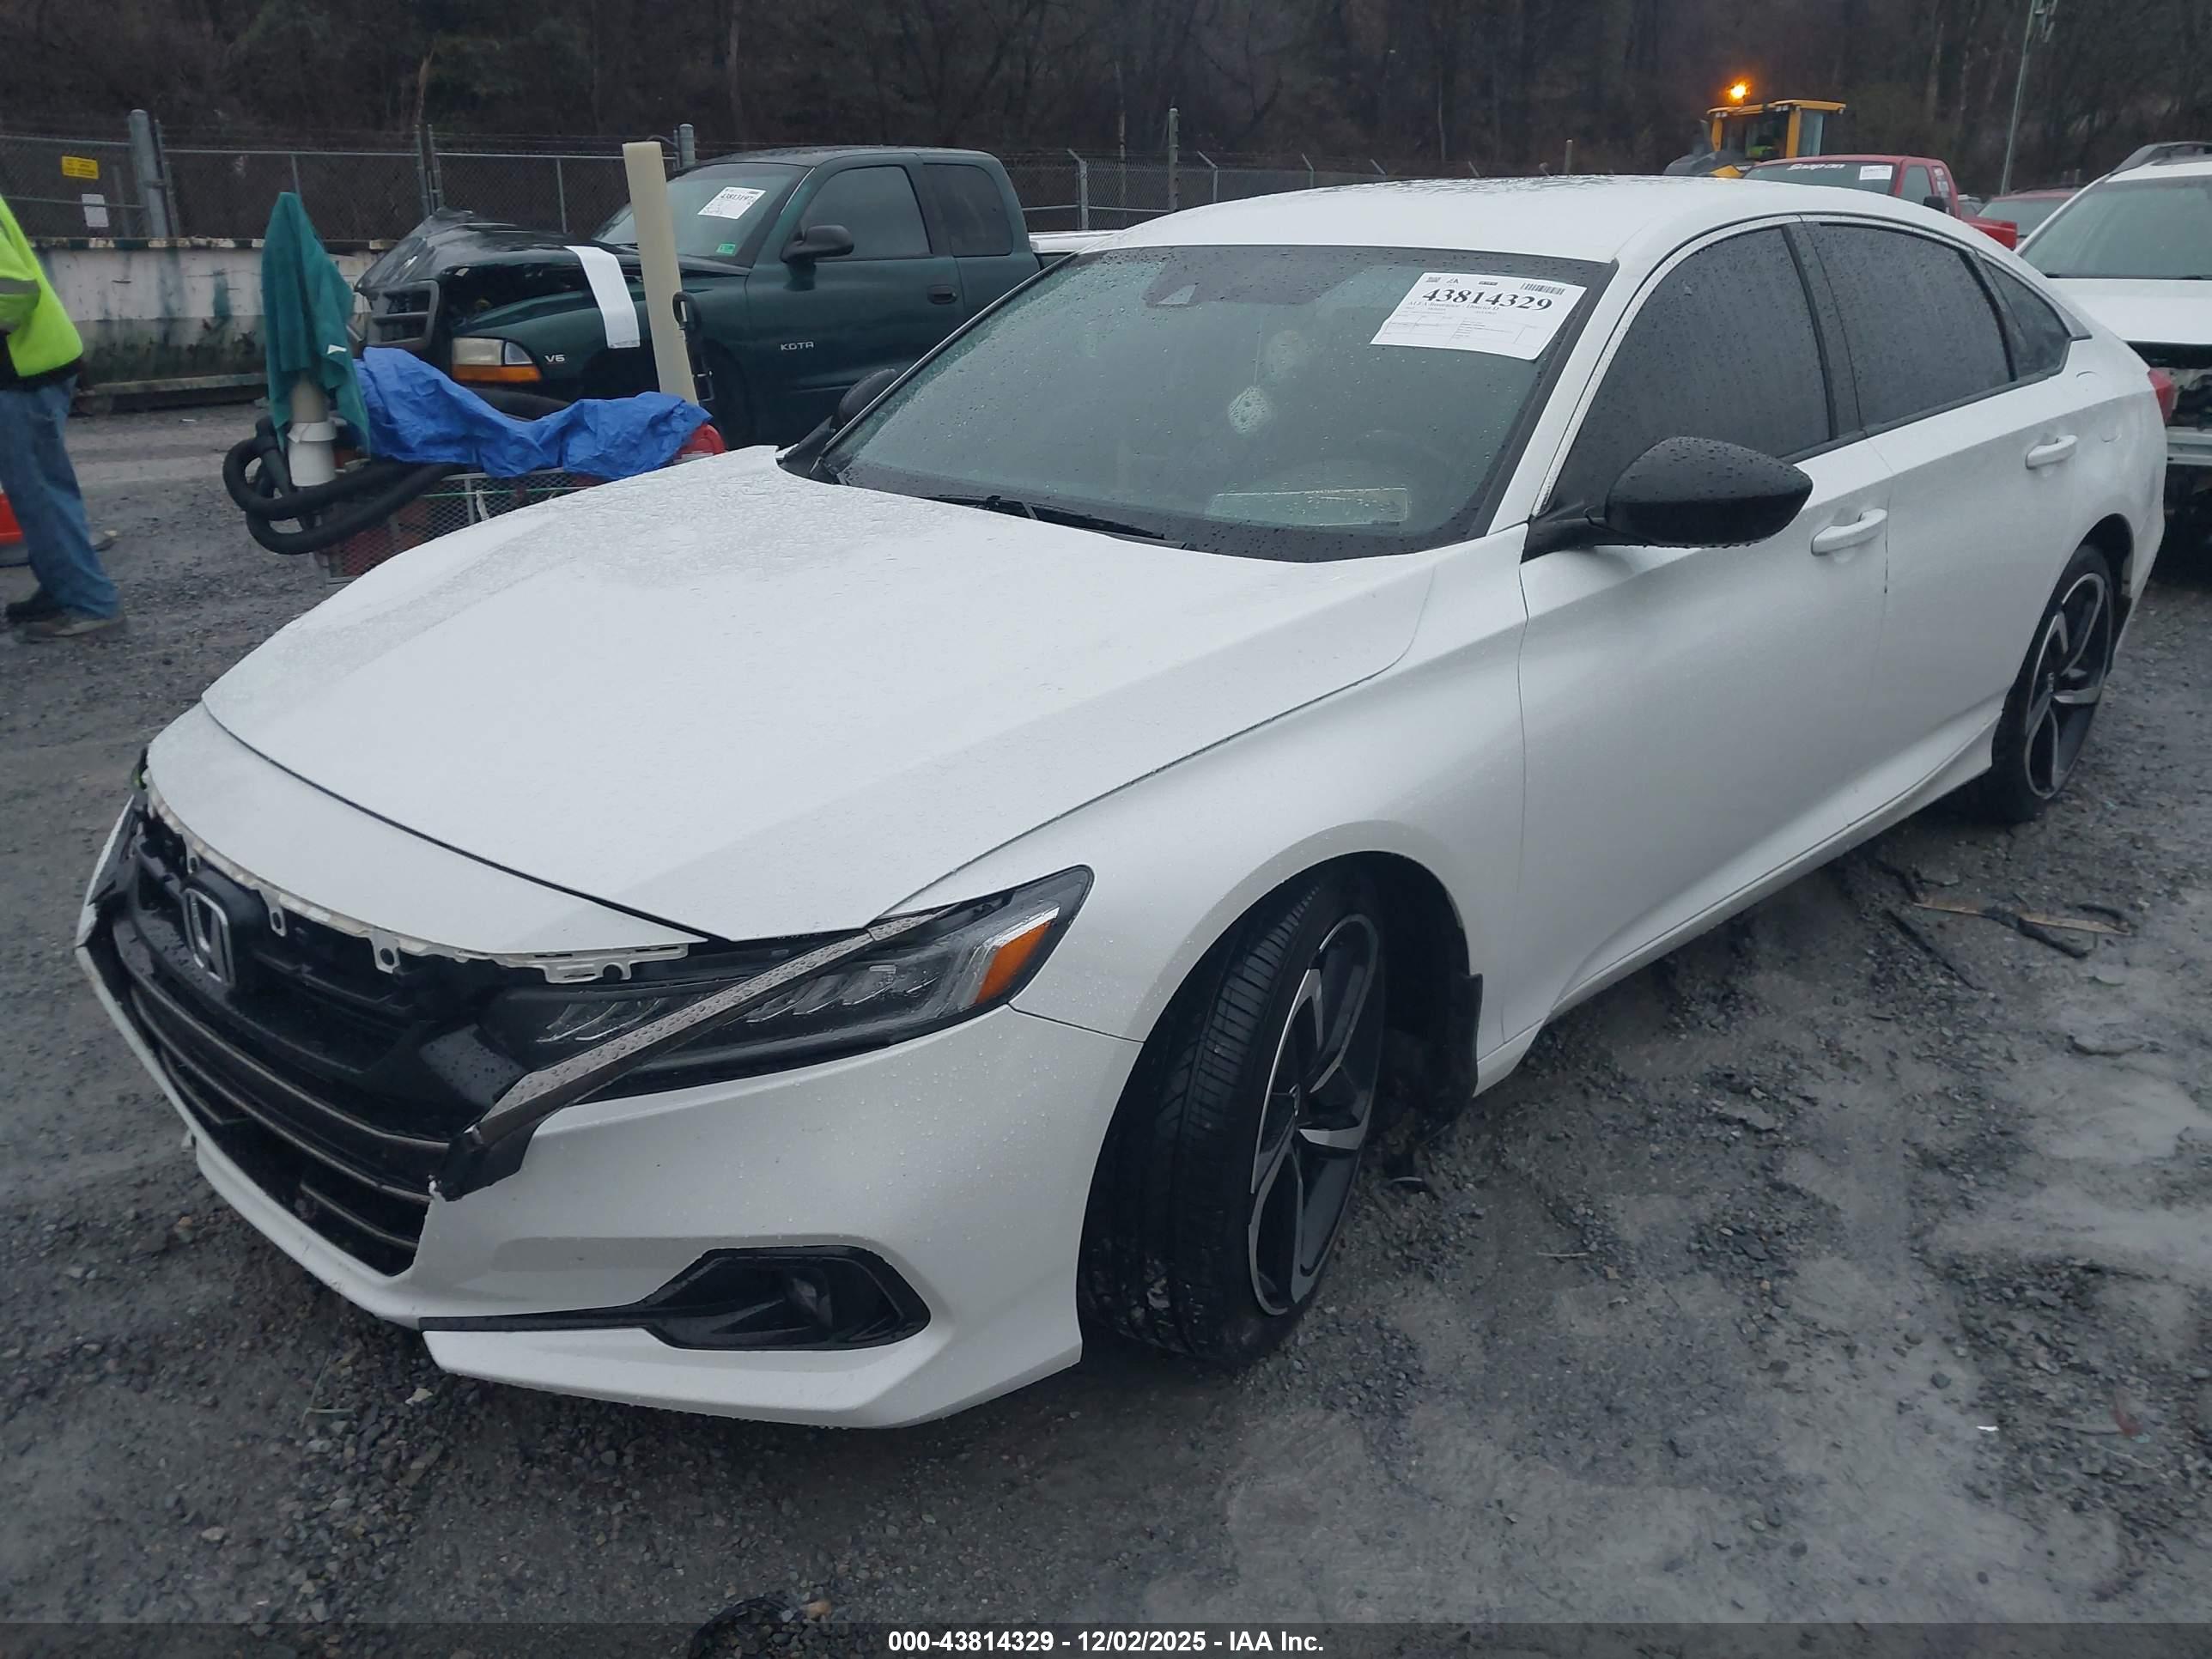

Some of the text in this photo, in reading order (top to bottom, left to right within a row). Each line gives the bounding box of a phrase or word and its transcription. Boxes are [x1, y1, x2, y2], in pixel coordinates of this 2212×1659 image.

[1422, 289, 1553, 310] 43814329
[781, 341, 814, 350] KOTA
[544, 354, 565, 362] V6
